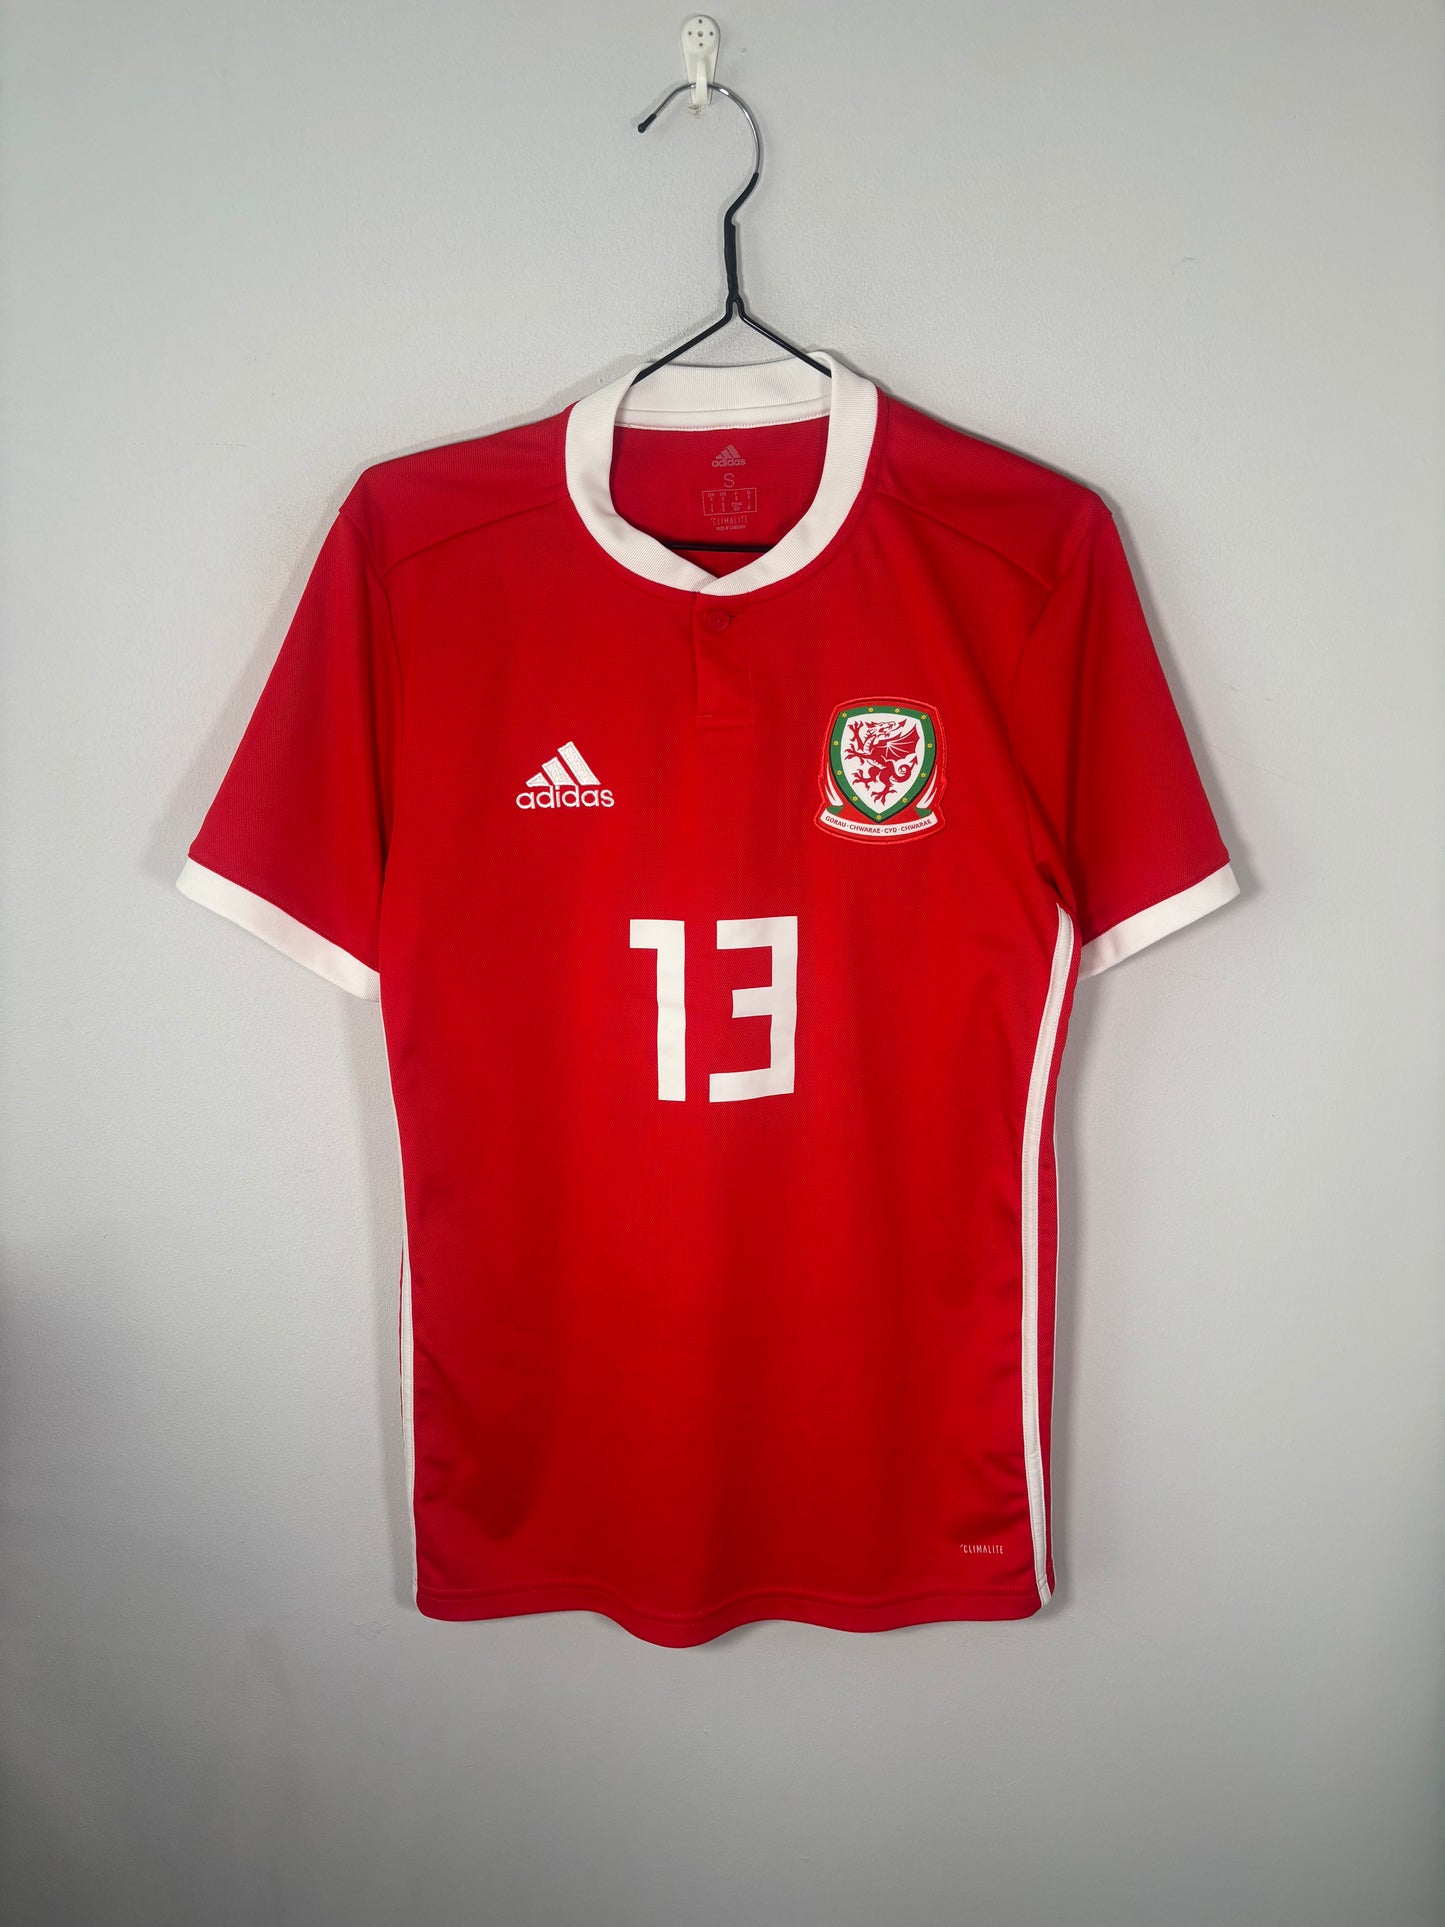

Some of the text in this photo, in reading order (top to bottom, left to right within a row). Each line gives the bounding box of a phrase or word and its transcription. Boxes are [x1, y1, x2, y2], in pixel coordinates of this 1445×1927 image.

[712, 458, 746, 467] adidas
[723, 473, 735, 488] S
[516, 785, 615, 809] adidas
[825, 815, 847, 828] GORAU
[849, 824, 881, 834] CHWARAE
[900, 819, 932, 832] CHWARAE
[629, 916, 798, 1103] 13
